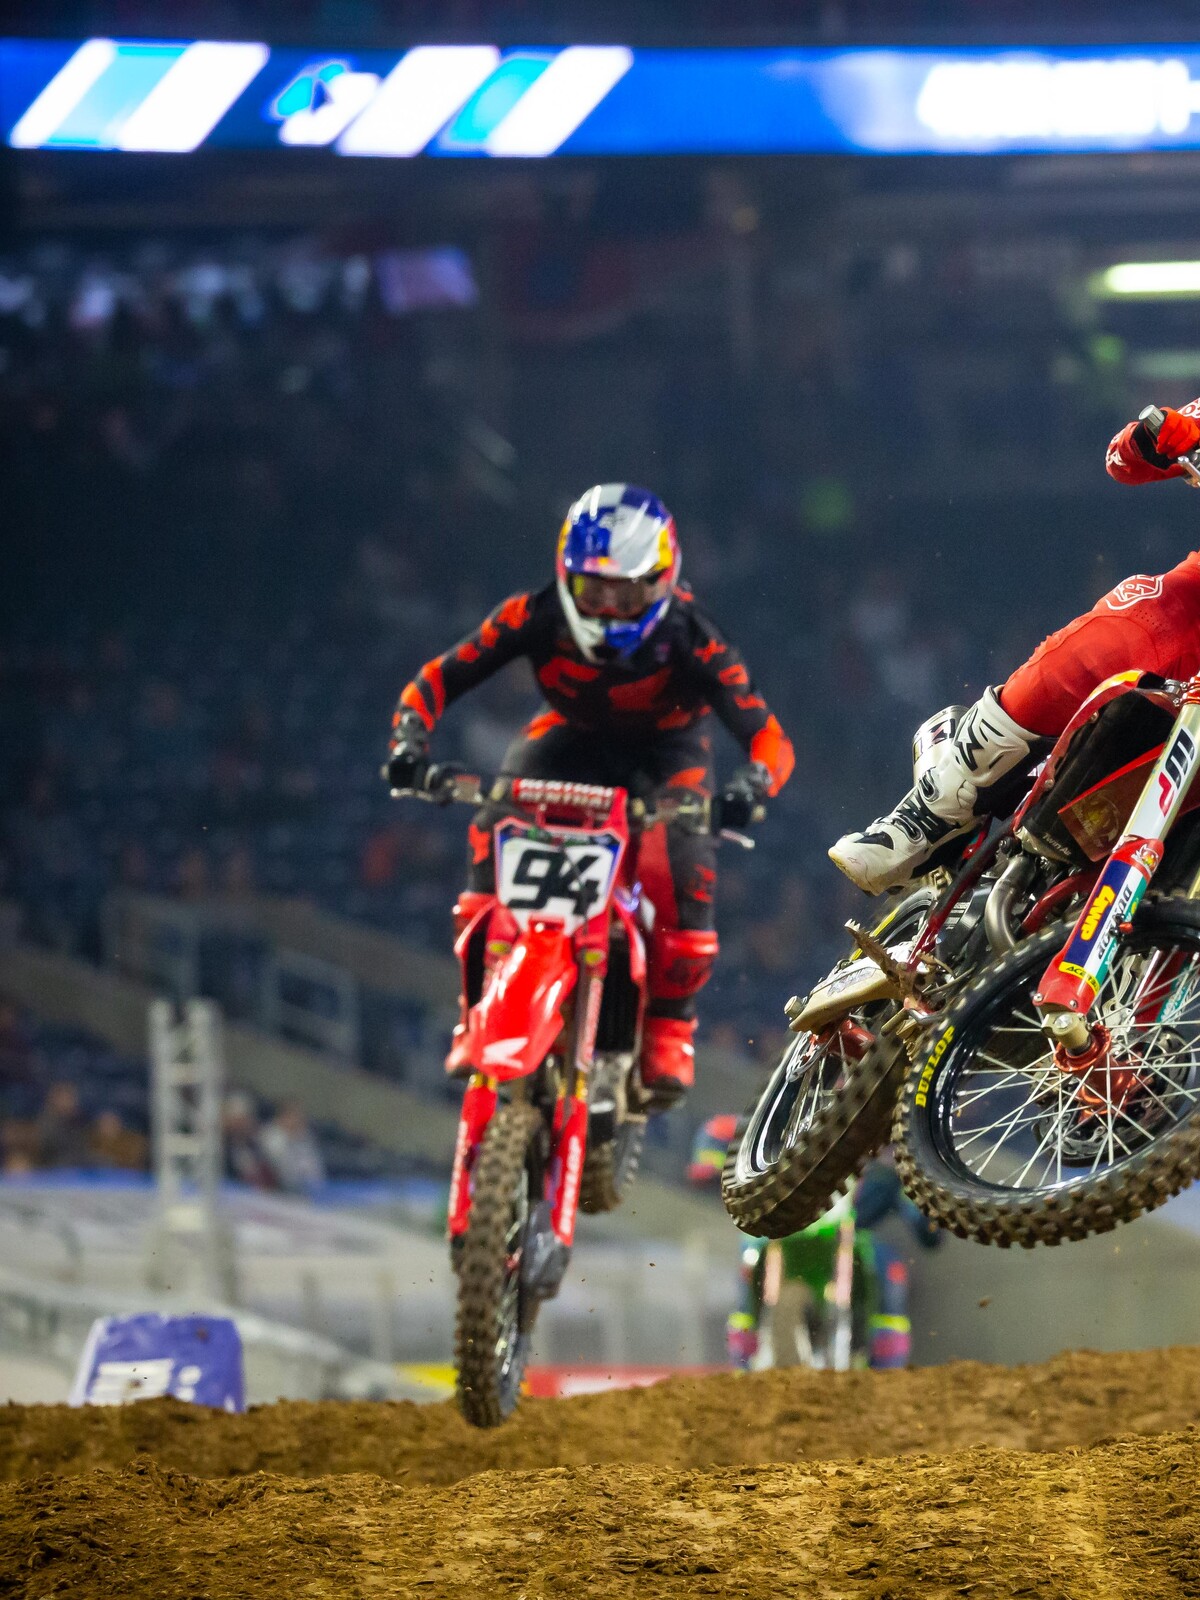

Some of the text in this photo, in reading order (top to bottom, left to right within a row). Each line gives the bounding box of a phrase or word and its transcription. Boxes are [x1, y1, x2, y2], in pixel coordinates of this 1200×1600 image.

[1042, 832, 1072, 857] Twin Air
[507, 848, 600, 916] 94
[915, 1025, 955, 1109] DUNLOP
